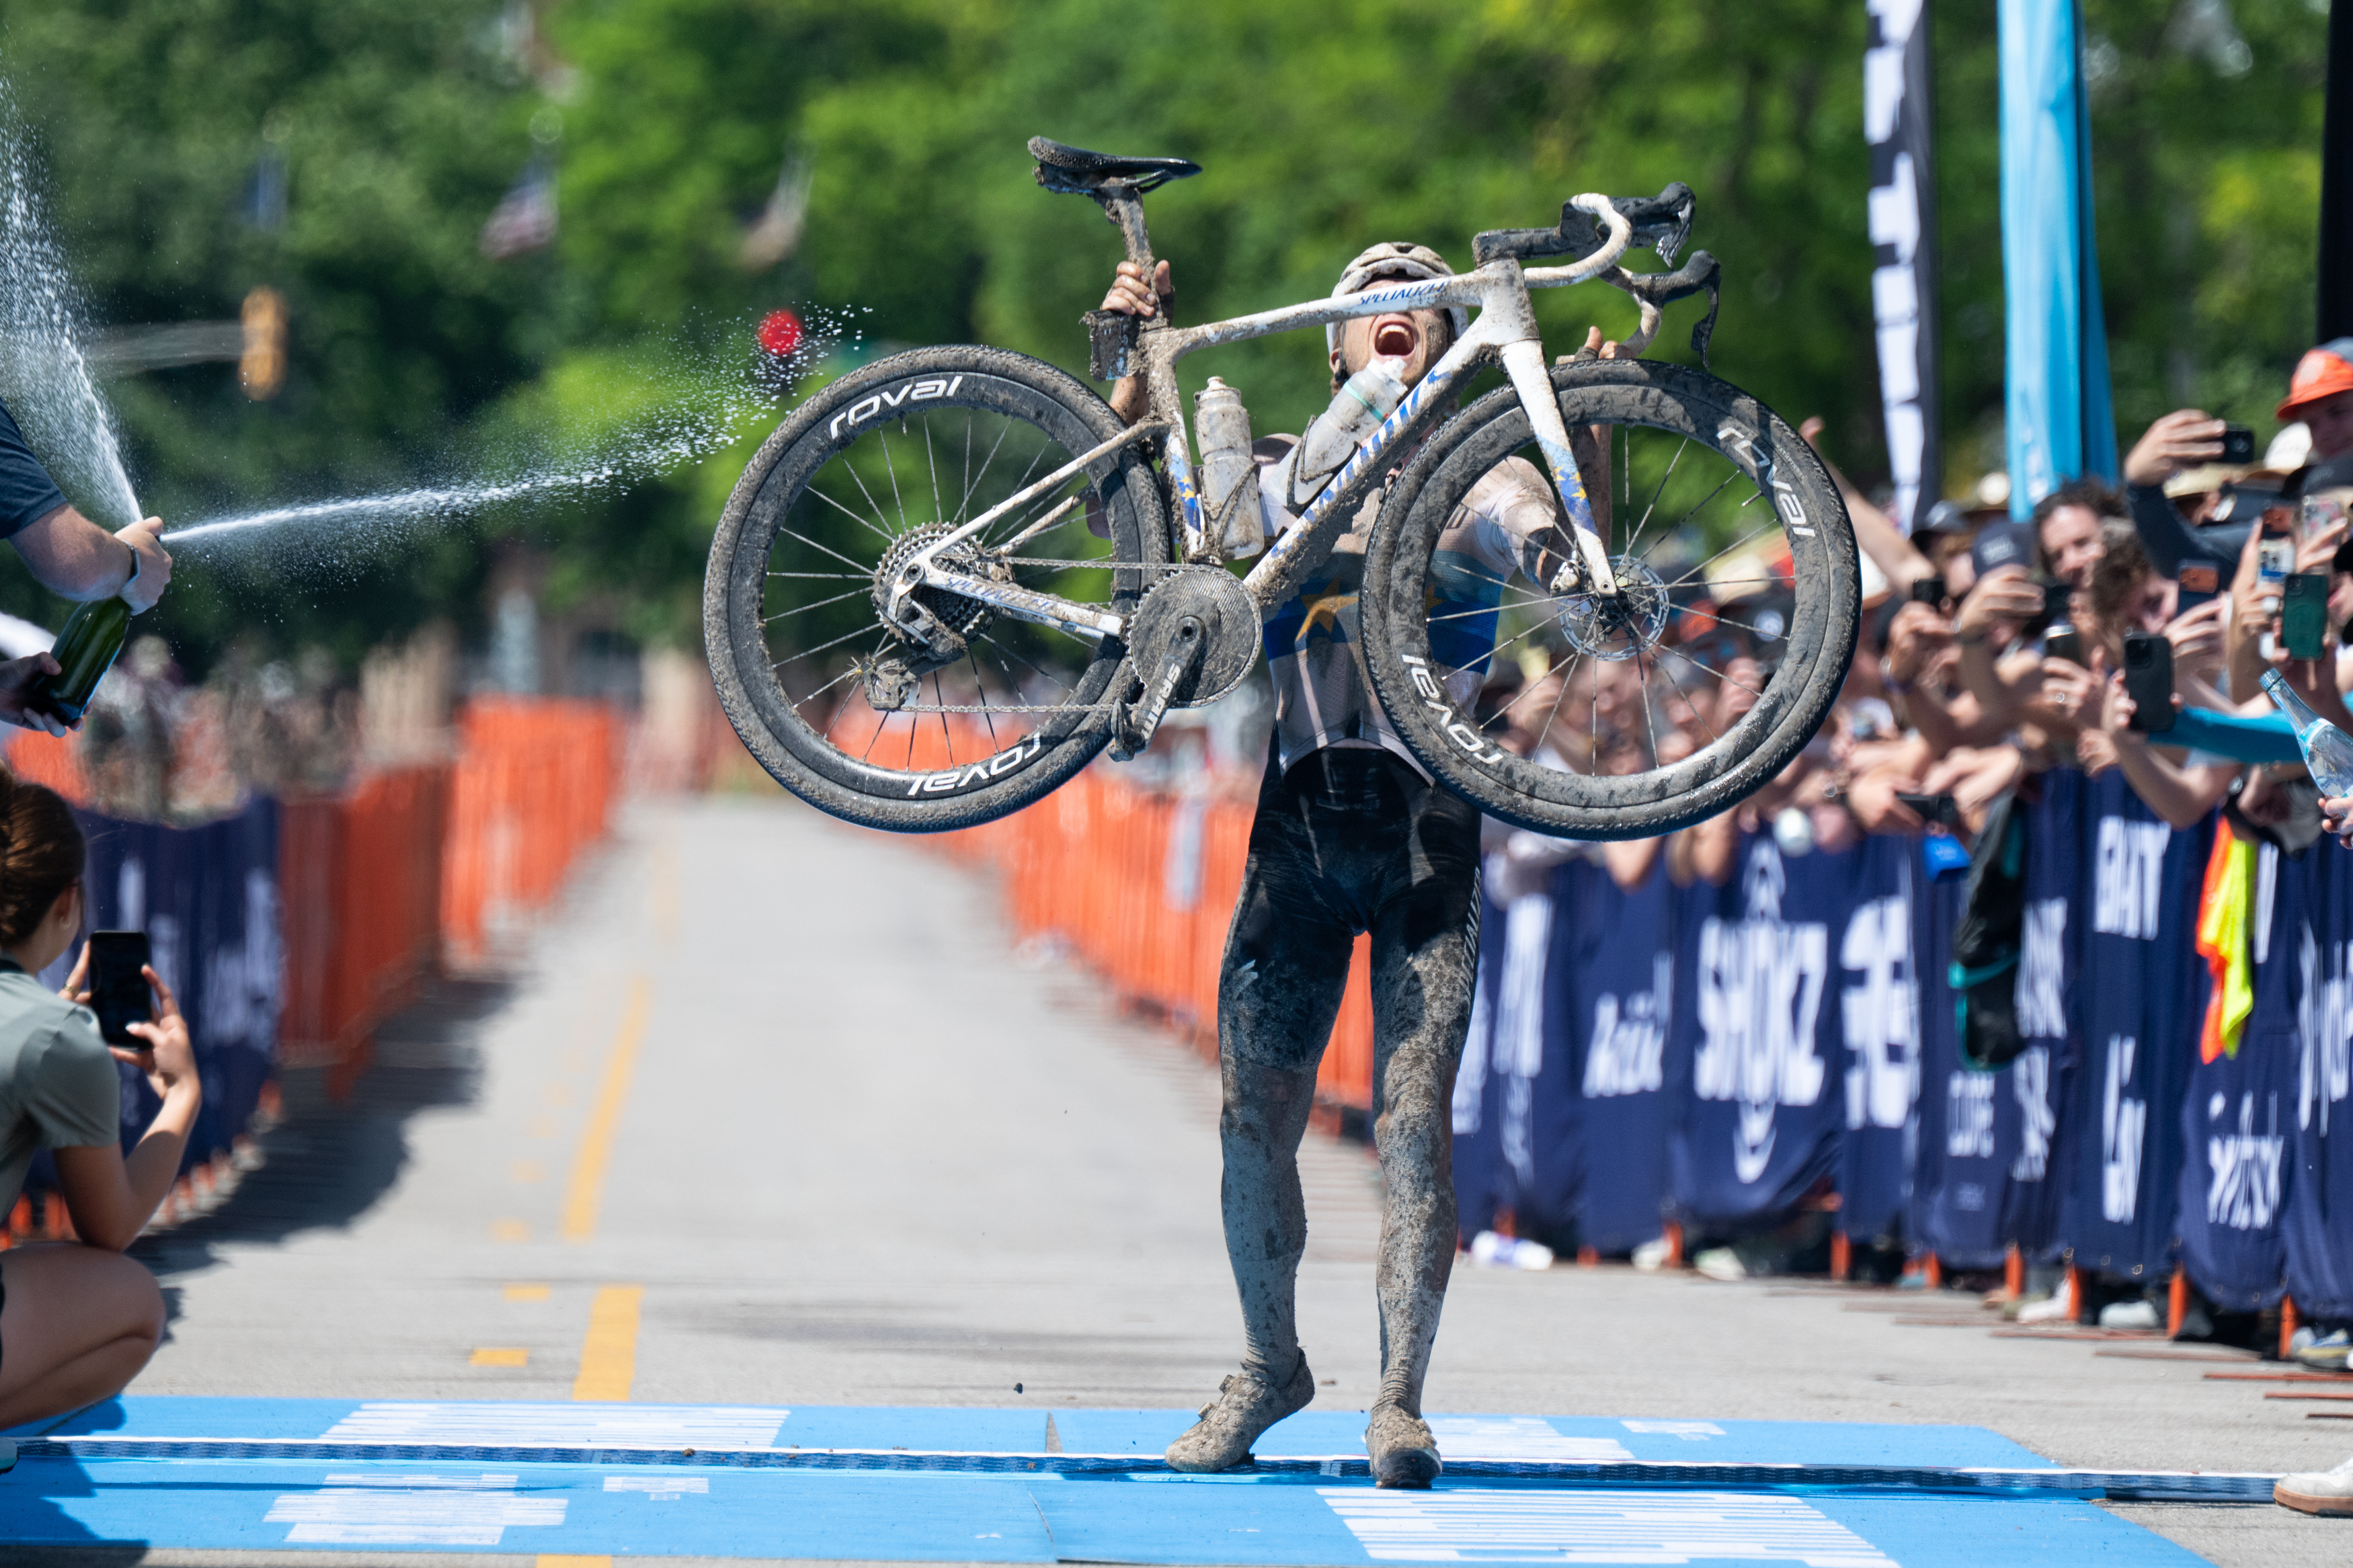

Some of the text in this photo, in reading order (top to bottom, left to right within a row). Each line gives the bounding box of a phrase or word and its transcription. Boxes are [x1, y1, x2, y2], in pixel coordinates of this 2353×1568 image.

[830, 375, 963, 440] roval
[1716, 426, 1816, 538] roval
[1140, 662, 1181, 740] SRAM
[1401, 653, 1504, 765] roval
[907, 731, 1041, 796] roval
